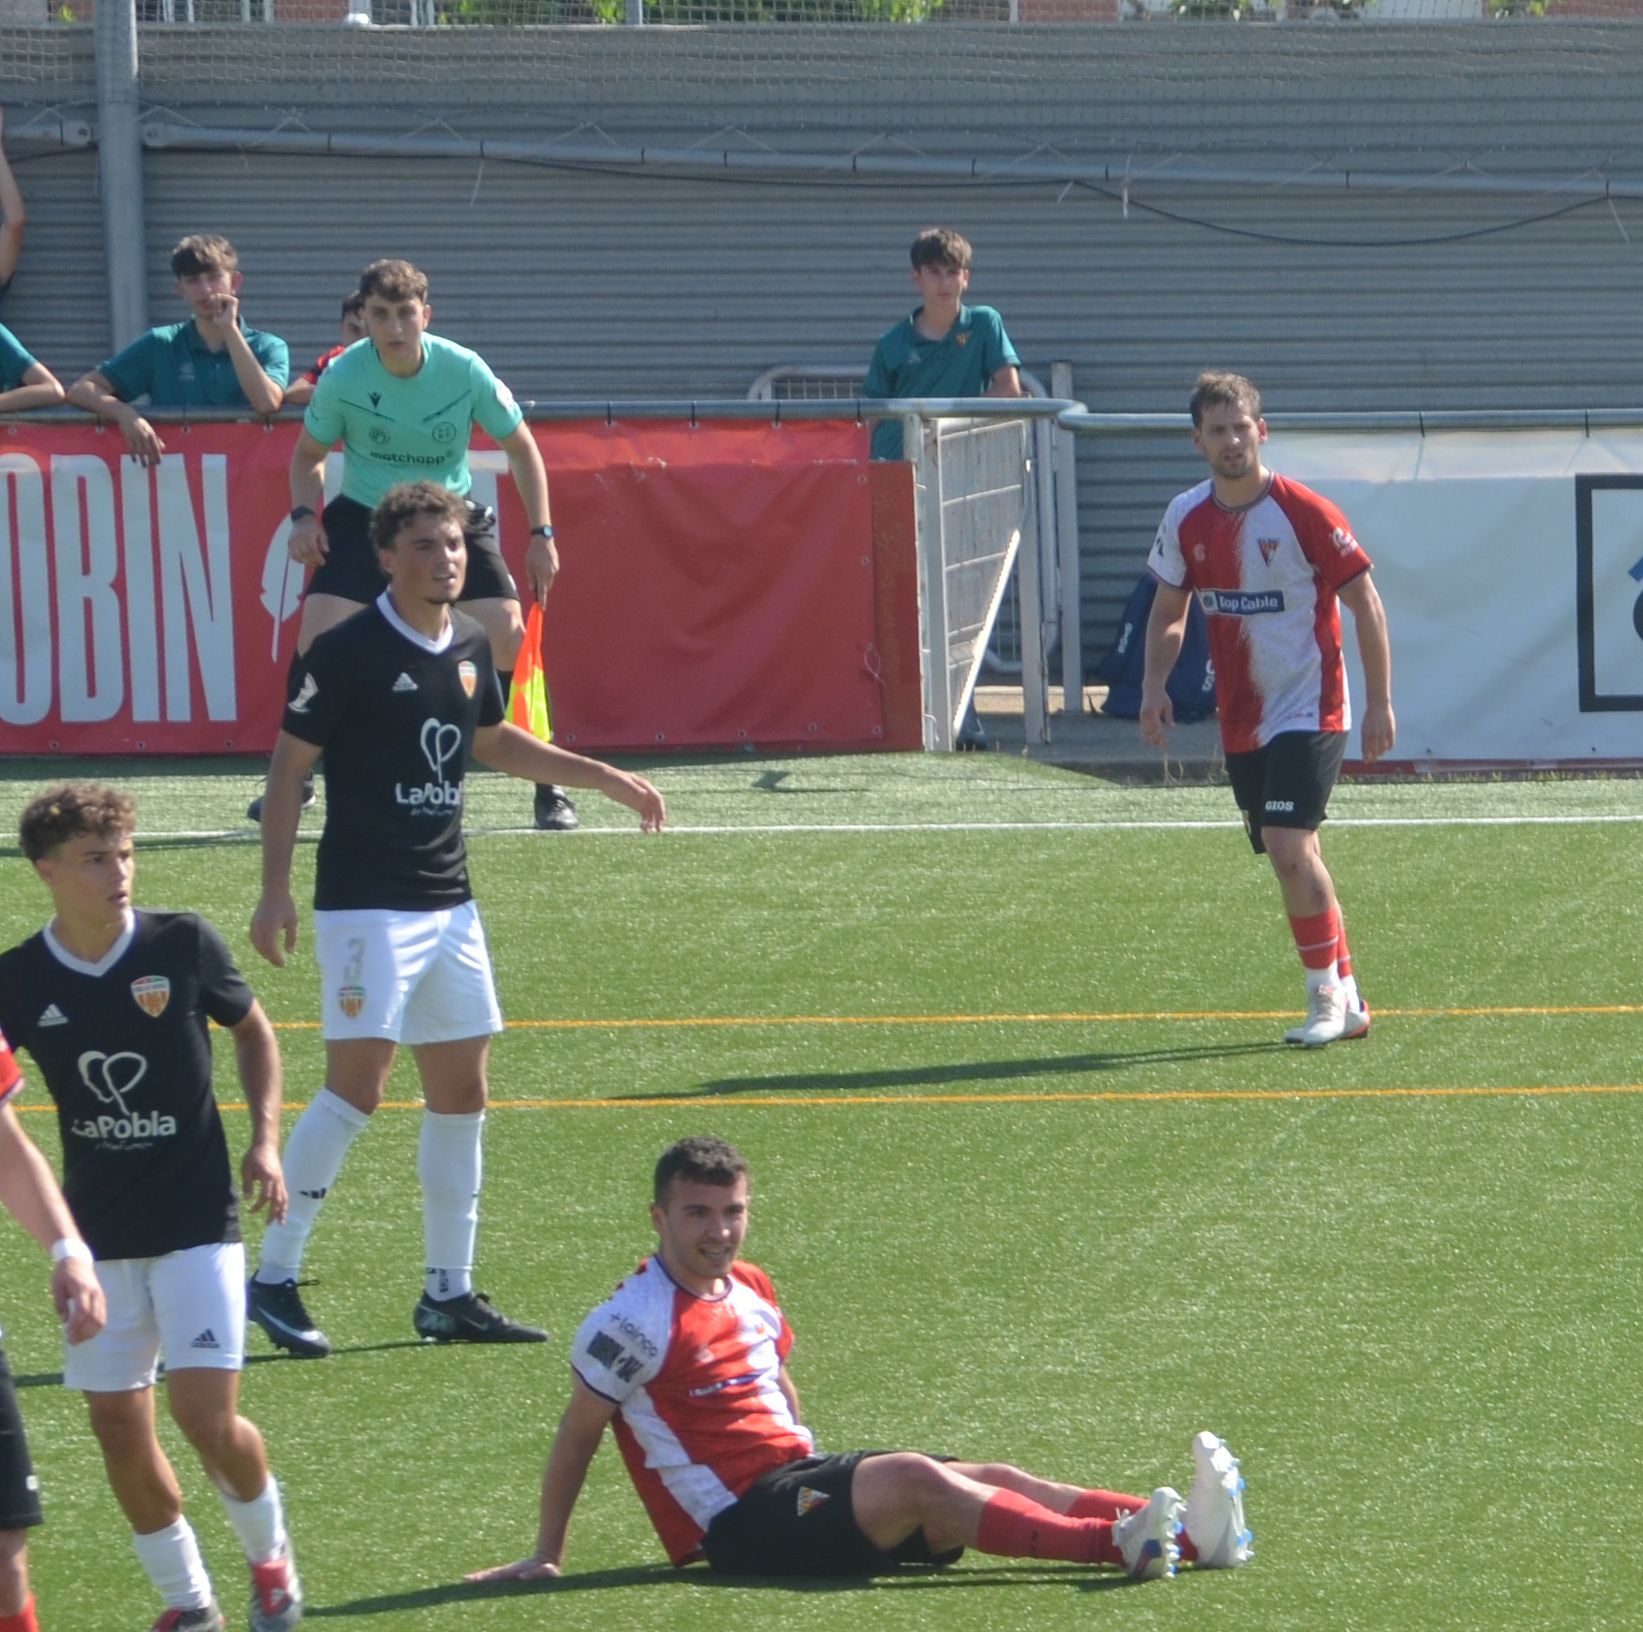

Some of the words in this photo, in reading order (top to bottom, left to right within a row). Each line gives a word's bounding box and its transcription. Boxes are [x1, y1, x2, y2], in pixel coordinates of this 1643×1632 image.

[1219, 595, 1239, 612] Top
[1240, 595, 1278, 610] Cable
[71, 1109, 176, 1138] LaPobla
